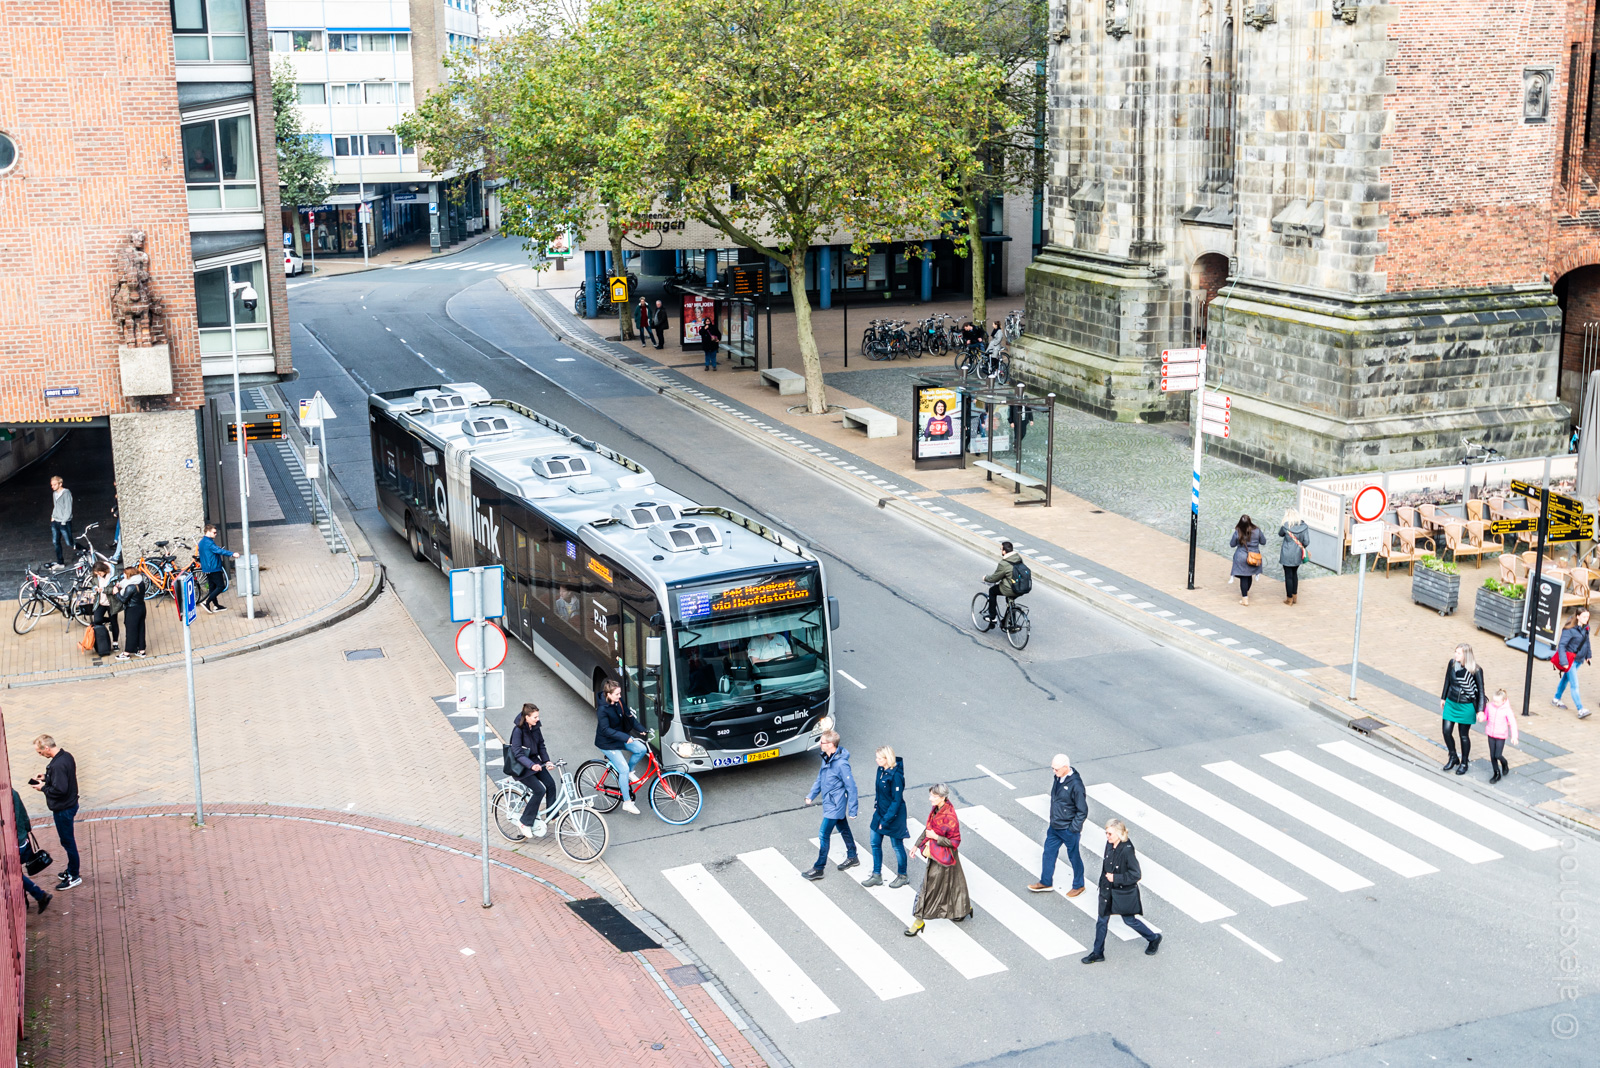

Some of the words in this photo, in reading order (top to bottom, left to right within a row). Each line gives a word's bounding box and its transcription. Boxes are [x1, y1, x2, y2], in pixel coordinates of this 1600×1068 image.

[472, 494, 501, 559] link
[187, 580, 193, 605] P
[712, 603, 731, 611] via
[733, 590, 809, 609] Hoofdstation
[594, 608, 608, 633] P+R
[748, 751, 777, 761] 77-BDL-4
